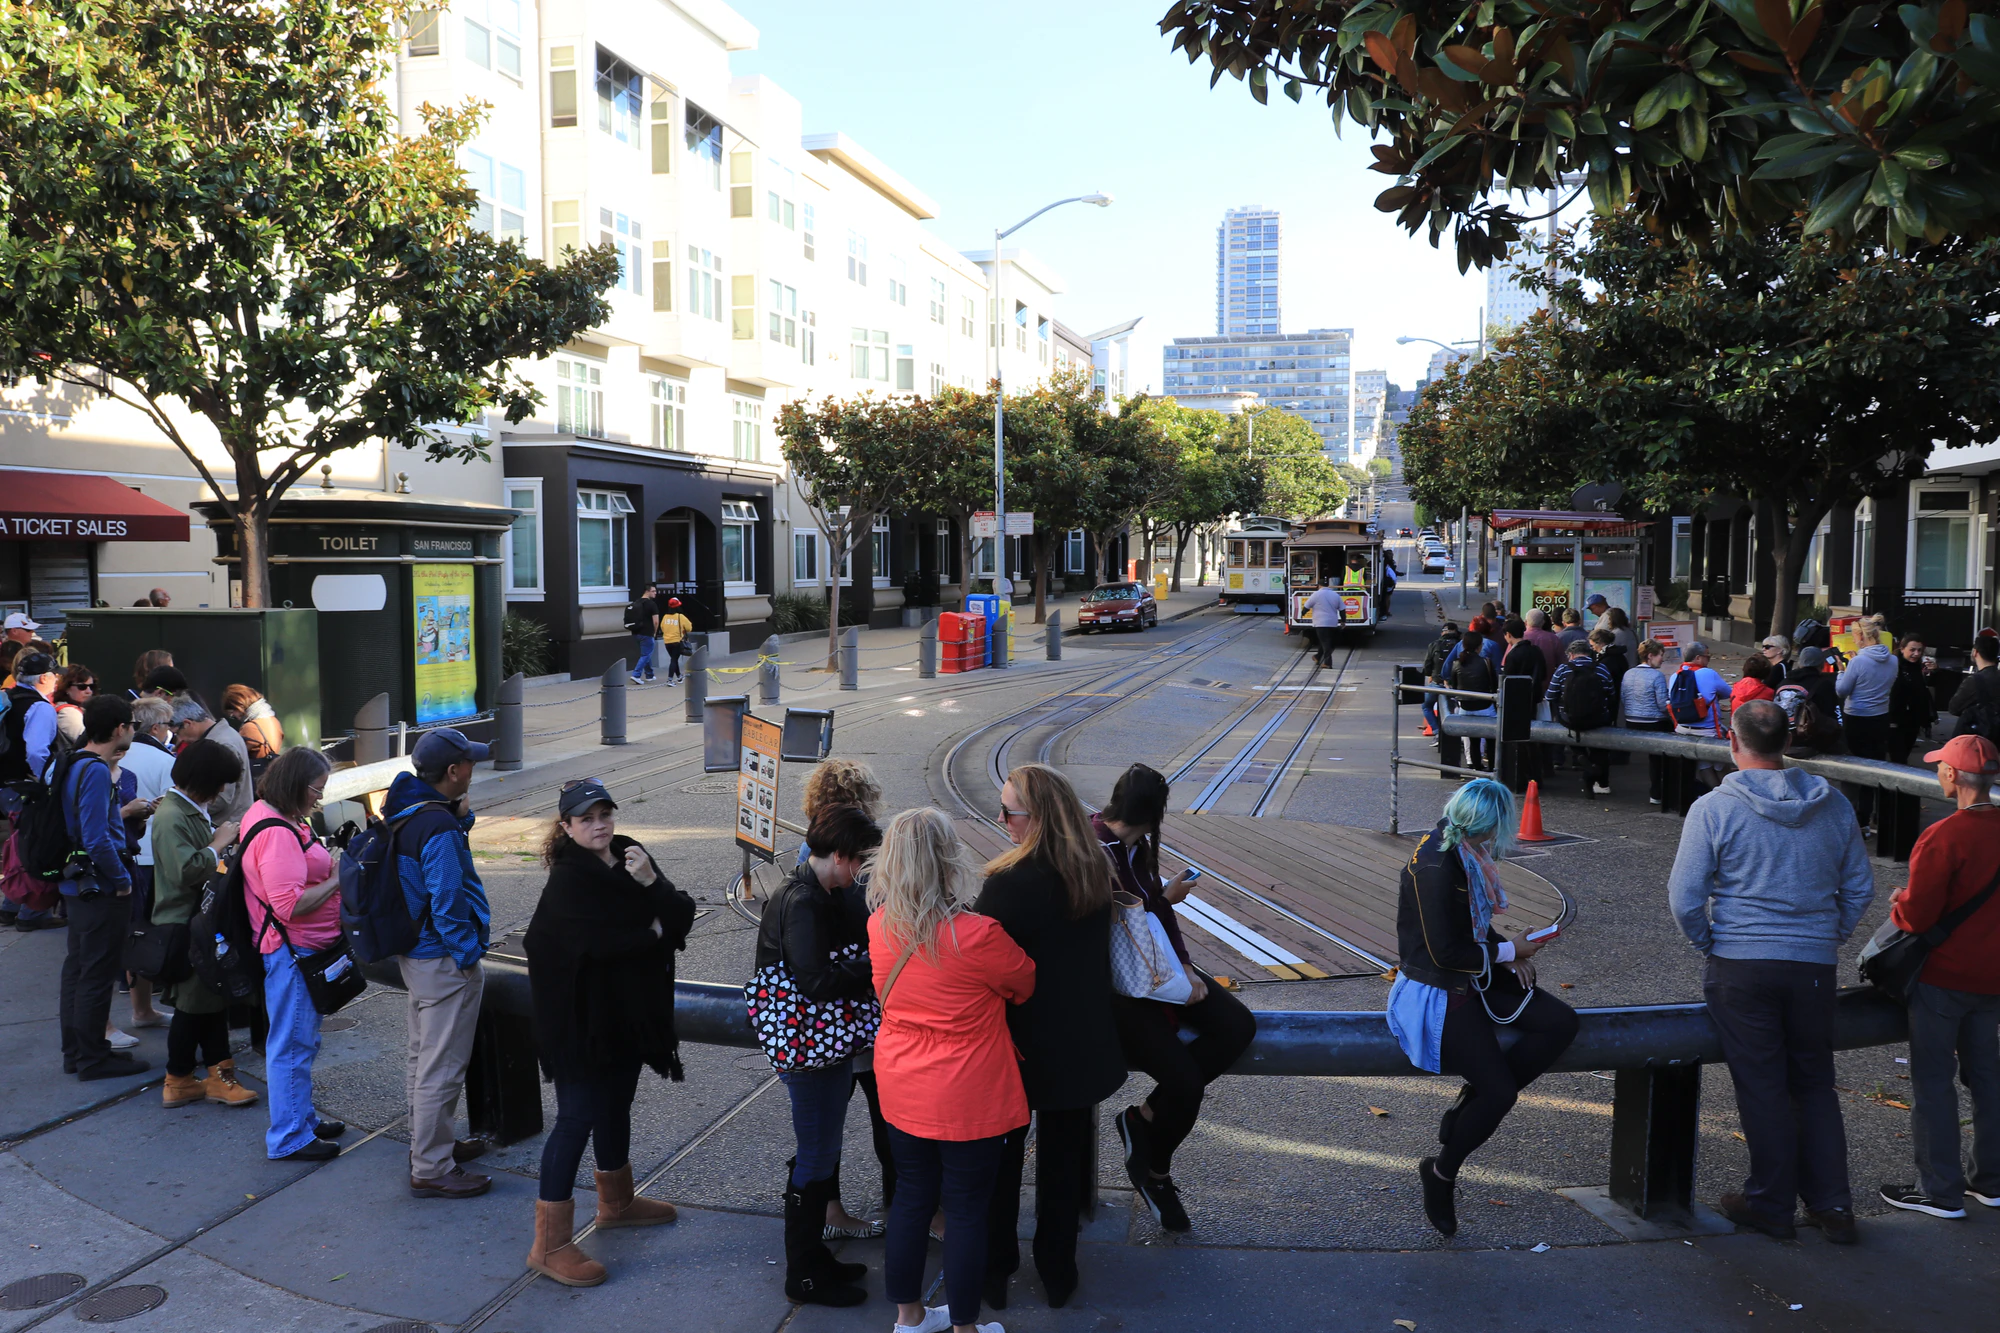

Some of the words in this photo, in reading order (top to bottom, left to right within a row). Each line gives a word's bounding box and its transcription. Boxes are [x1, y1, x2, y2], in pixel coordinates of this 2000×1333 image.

[11, 518, 73, 535] TICKET
[76, 520, 127, 536] SALES
[319, 537, 378, 550] TOILET
[414, 540, 430, 550] SAN
[431, 541, 472, 551] FRANCISCO
[1535, 596, 1552, 604] GO
[1554, 596, 1567, 604] TO
[743, 726, 763, 742] CABLE
[764, 734, 779, 748] CAR
